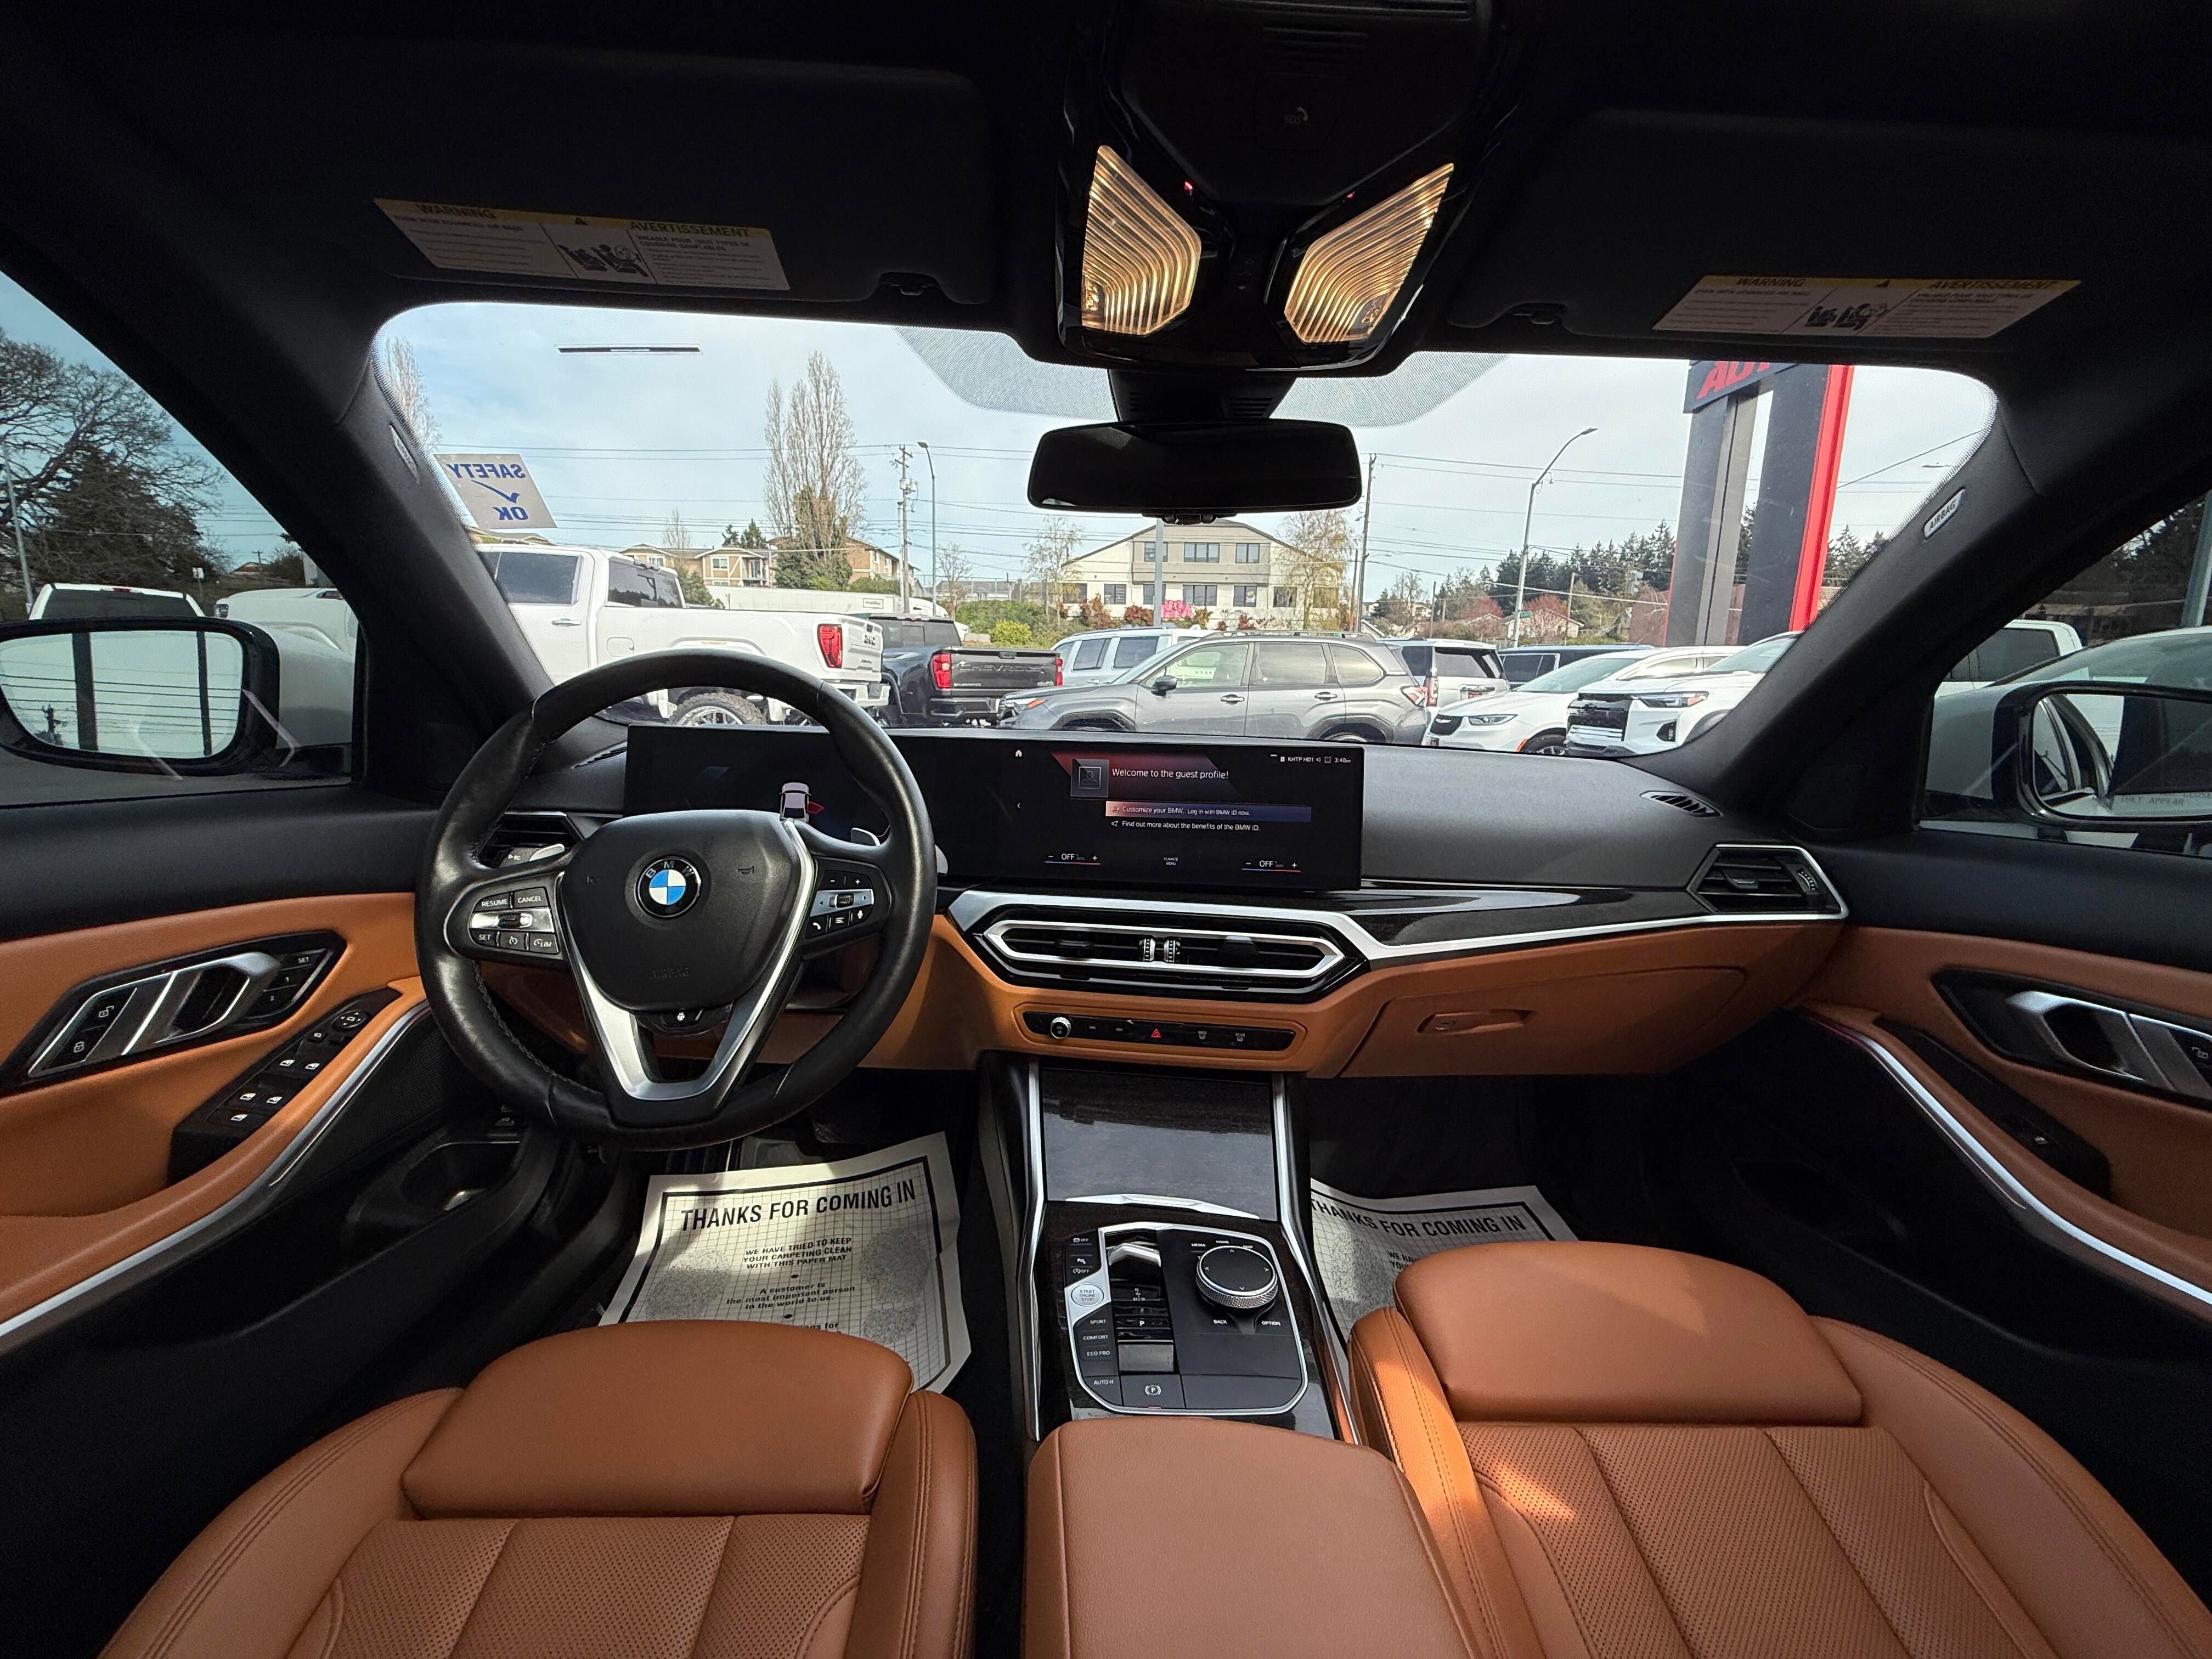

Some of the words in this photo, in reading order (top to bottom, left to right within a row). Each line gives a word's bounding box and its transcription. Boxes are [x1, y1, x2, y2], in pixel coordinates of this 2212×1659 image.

[417, 204, 496, 219] WARNING
[629, 221, 749, 237] AVERTISSEMENT
[1735, 278, 1806, 286] WARNING
[1930, 280, 2058, 290] AVERTISSEMENT
[1696, 360, 1770, 400] AU
[1928, 499, 1957, 532] AIRBAG
[1112, 768, 1149, 778] Welcome
[1150, 769, 1159, 777] to
[1161, 769, 1173, 778] the
[1176, 771, 1199, 780] guest
[1200, 769, 1229, 780] profile!
[1122, 805, 1153, 814] Customize
[1187, 808, 1198, 816] Log
[1122, 820, 1135, 828] Find
[1163, 821, 1180, 830] about
[1192, 822, 1215, 831] benefits
[645, 860, 695, 879] BMW
[1259, 860, 1274, 868] OFF
[481, 898, 509, 907] RESUME
[680, 1204, 762, 1232] THANKS
[769, 1199, 809, 1221] FOR
[816, 1186, 893, 1214] COMING
[896, 1178, 916, 1204] IN
[1379, 1220, 1421, 1238] FOR
[1421, 1217, 1502, 1237] COMING
[1503, 1215, 1527, 1231] IN
[762, 1245, 786, 1254] HAVE
[788, 1241, 814, 1252] TRIED
[816, 1238, 828, 1247] TO
[743, 1255, 769, 1263] YOUR
[771, 1248, 821, 1261] CARPETING
[824, 1246, 852, 1255] CLEAN
[1387, 1251, 1401, 1260] WE
[773, 1259, 794, 1267] THIS
[797, 1256, 826, 1266] PAPER
[1390, 1260, 1409, 1270] YOU
[769, 1284, 815, 1293] customer
[772, 1289, 821, 1302] important
[822, 1285, 856, 1296] person
[776, 1297, 805, 1307] world
